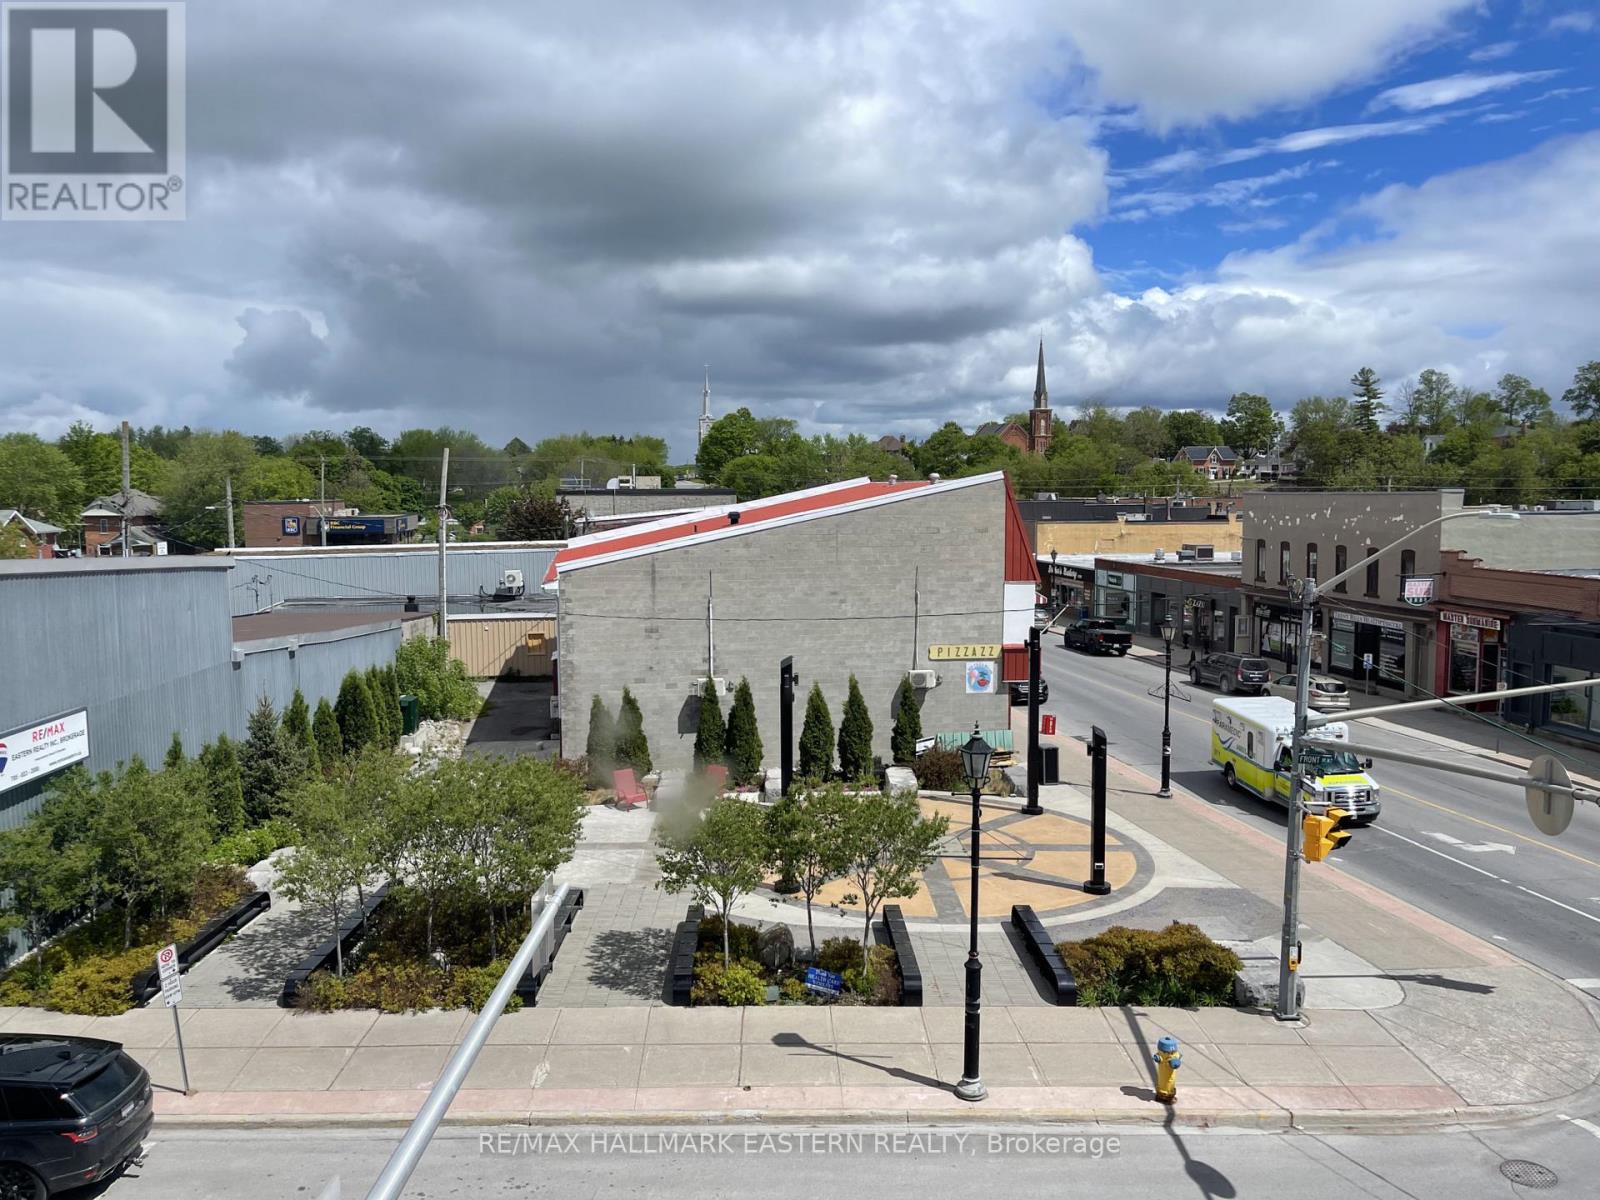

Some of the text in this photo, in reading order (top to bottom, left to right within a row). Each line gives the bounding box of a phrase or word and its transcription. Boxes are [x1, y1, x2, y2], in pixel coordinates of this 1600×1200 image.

[1443, 612, 1465, 623] MASTER
[937, 646, 994, 657] PIZZAZZ
[32, 722, 65, 742] RE/MAX
[1215, 719, 1241, 738] PARAMEDIC
[11, 748, 33, 761] EASTERN
[33, 742, 49, 752] REALTY
[60, 729, 85, 744] BROKERAGE
[1300, 755, 1320, 765] FRONT
